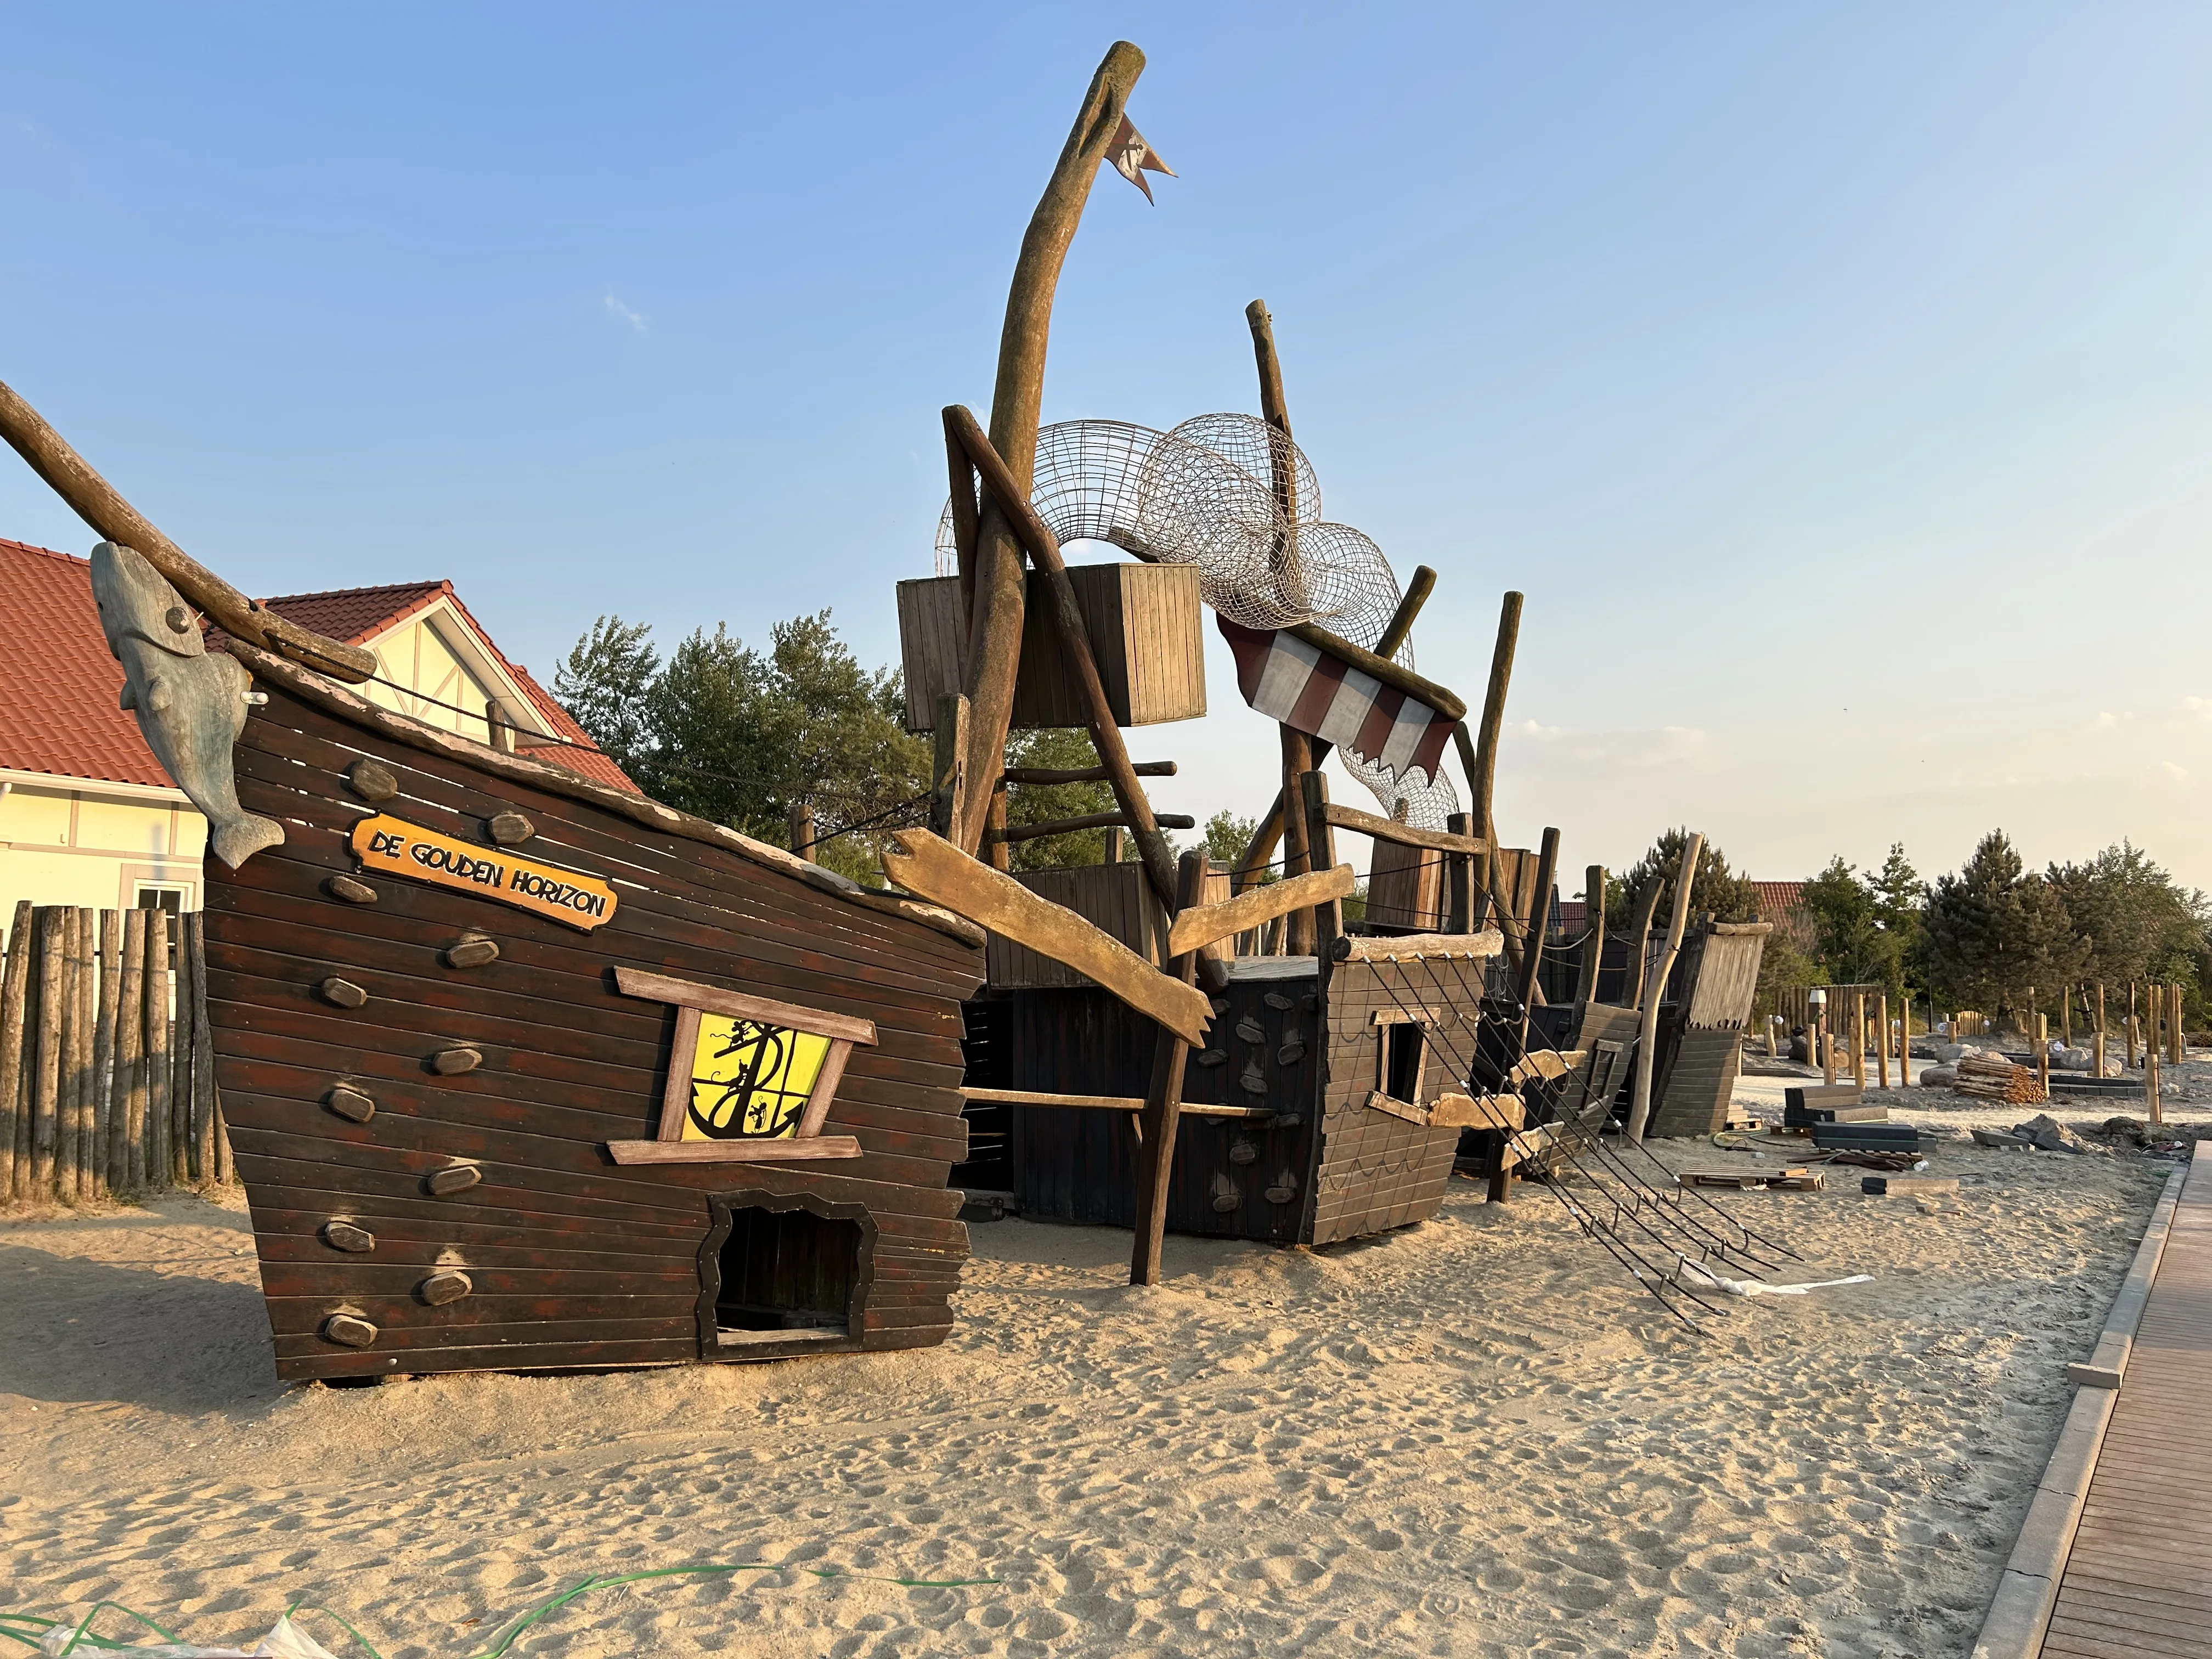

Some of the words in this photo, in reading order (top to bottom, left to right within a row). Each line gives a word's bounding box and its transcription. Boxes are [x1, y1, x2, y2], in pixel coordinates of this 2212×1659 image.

[368, 830, 405, 858] DE
[410, 843, 504, 887] GOUDEN
[510, 869, 606, 917] HORIZON
